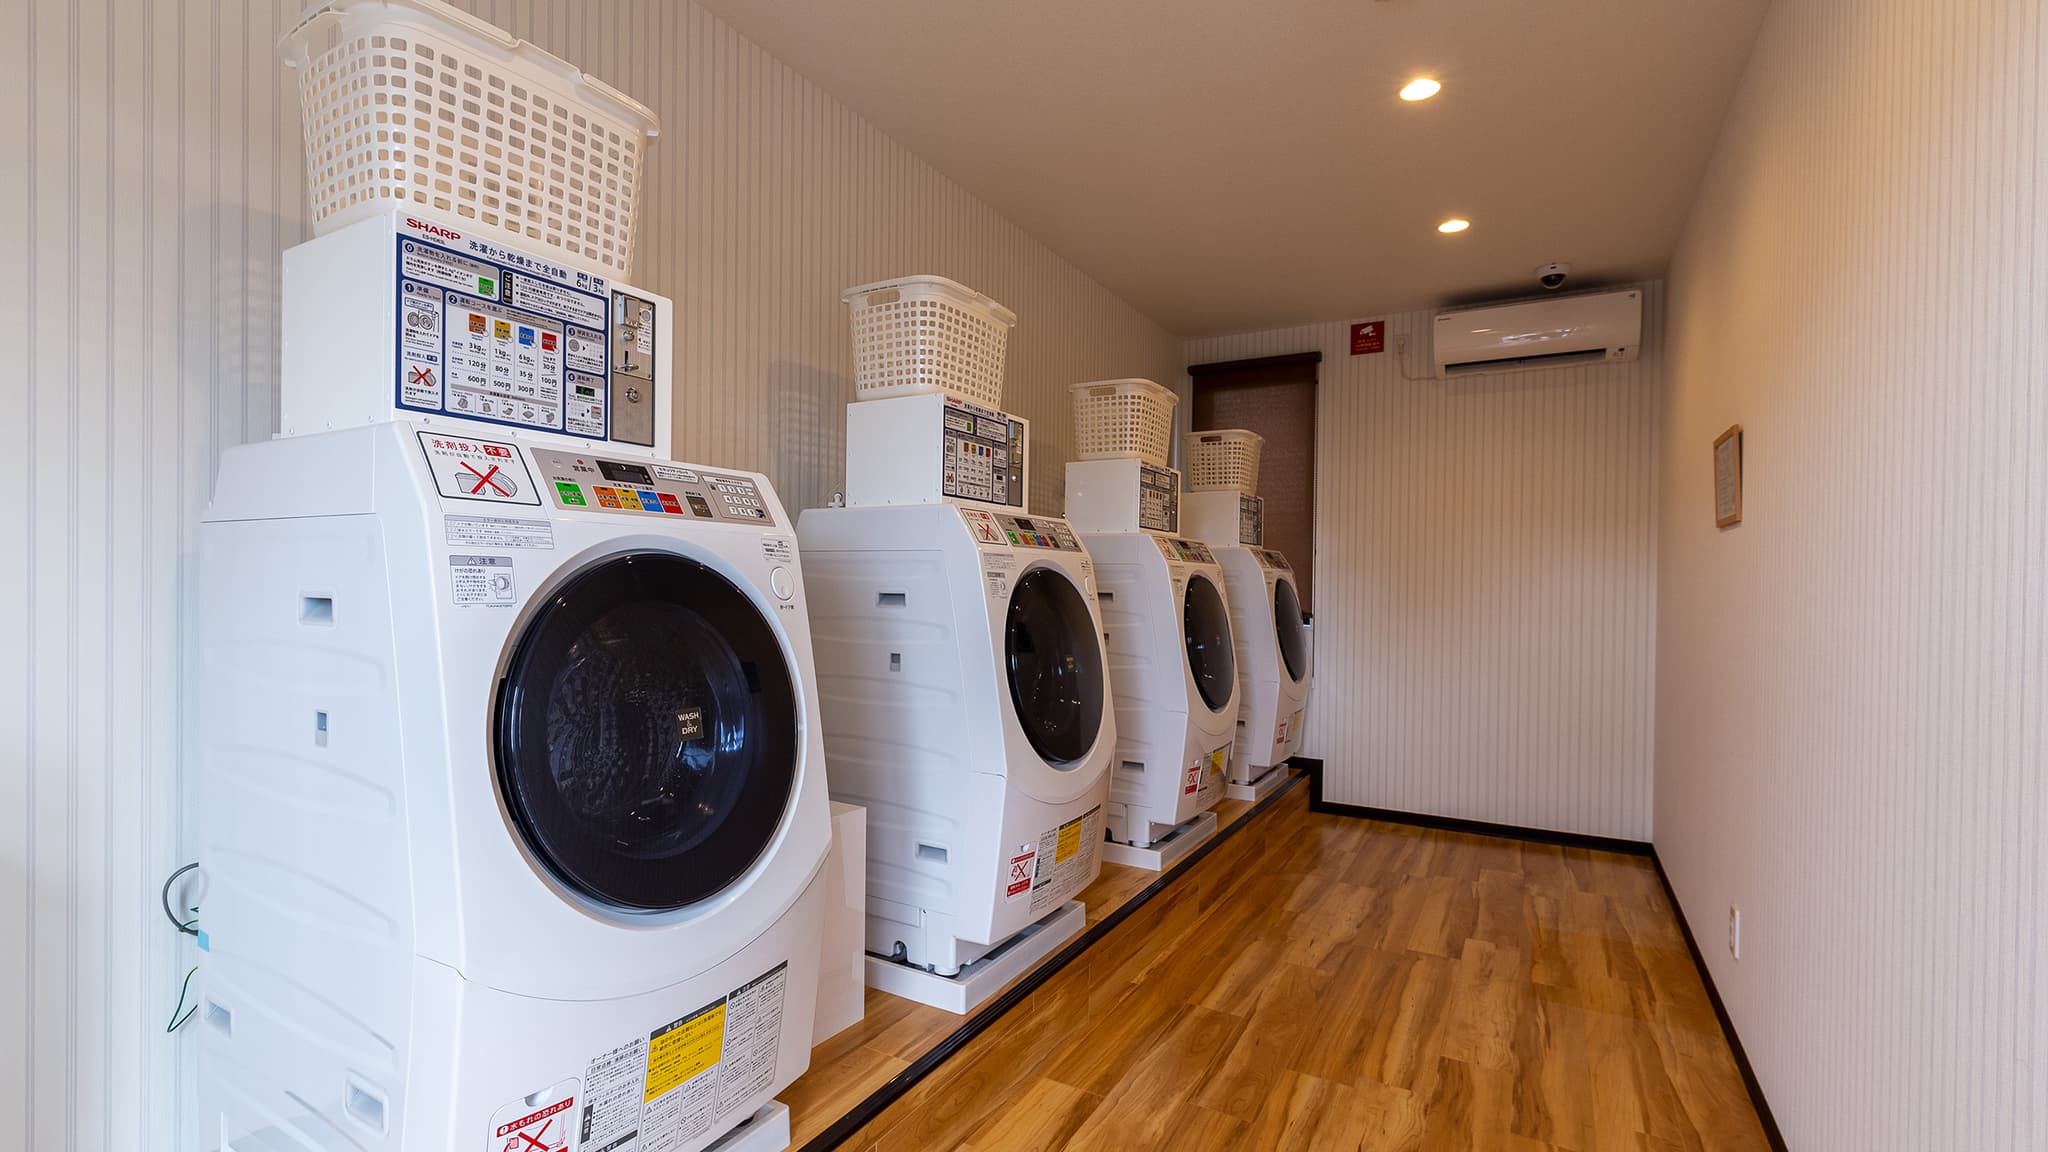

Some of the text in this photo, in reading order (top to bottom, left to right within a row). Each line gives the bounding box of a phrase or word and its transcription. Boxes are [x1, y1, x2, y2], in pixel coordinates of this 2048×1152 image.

[406, 217, 461, 241] SHARP
[469, 240, 567, 280] 洗濯から乾燥まで全自動
[407, 351, 426, 359] 洗剤投入
[468, 359, 555, 379] 120分 80分 35分 30分
[468, 375, 557, 395] 600円 500円 300円 100円
[431, 438, 510, 457] 洗剤投入 不要
[434, 450, 514, 464] 洗剤が自動で投入されます
[572, 465, 595, 473] 営業中
[479, 557, 496, 565] 注意
[677, 711, 699, 721] WASH
[681, 725, 698, 735] DRY
[591, 1037, 645, 1064] オーナー様へのお願い
